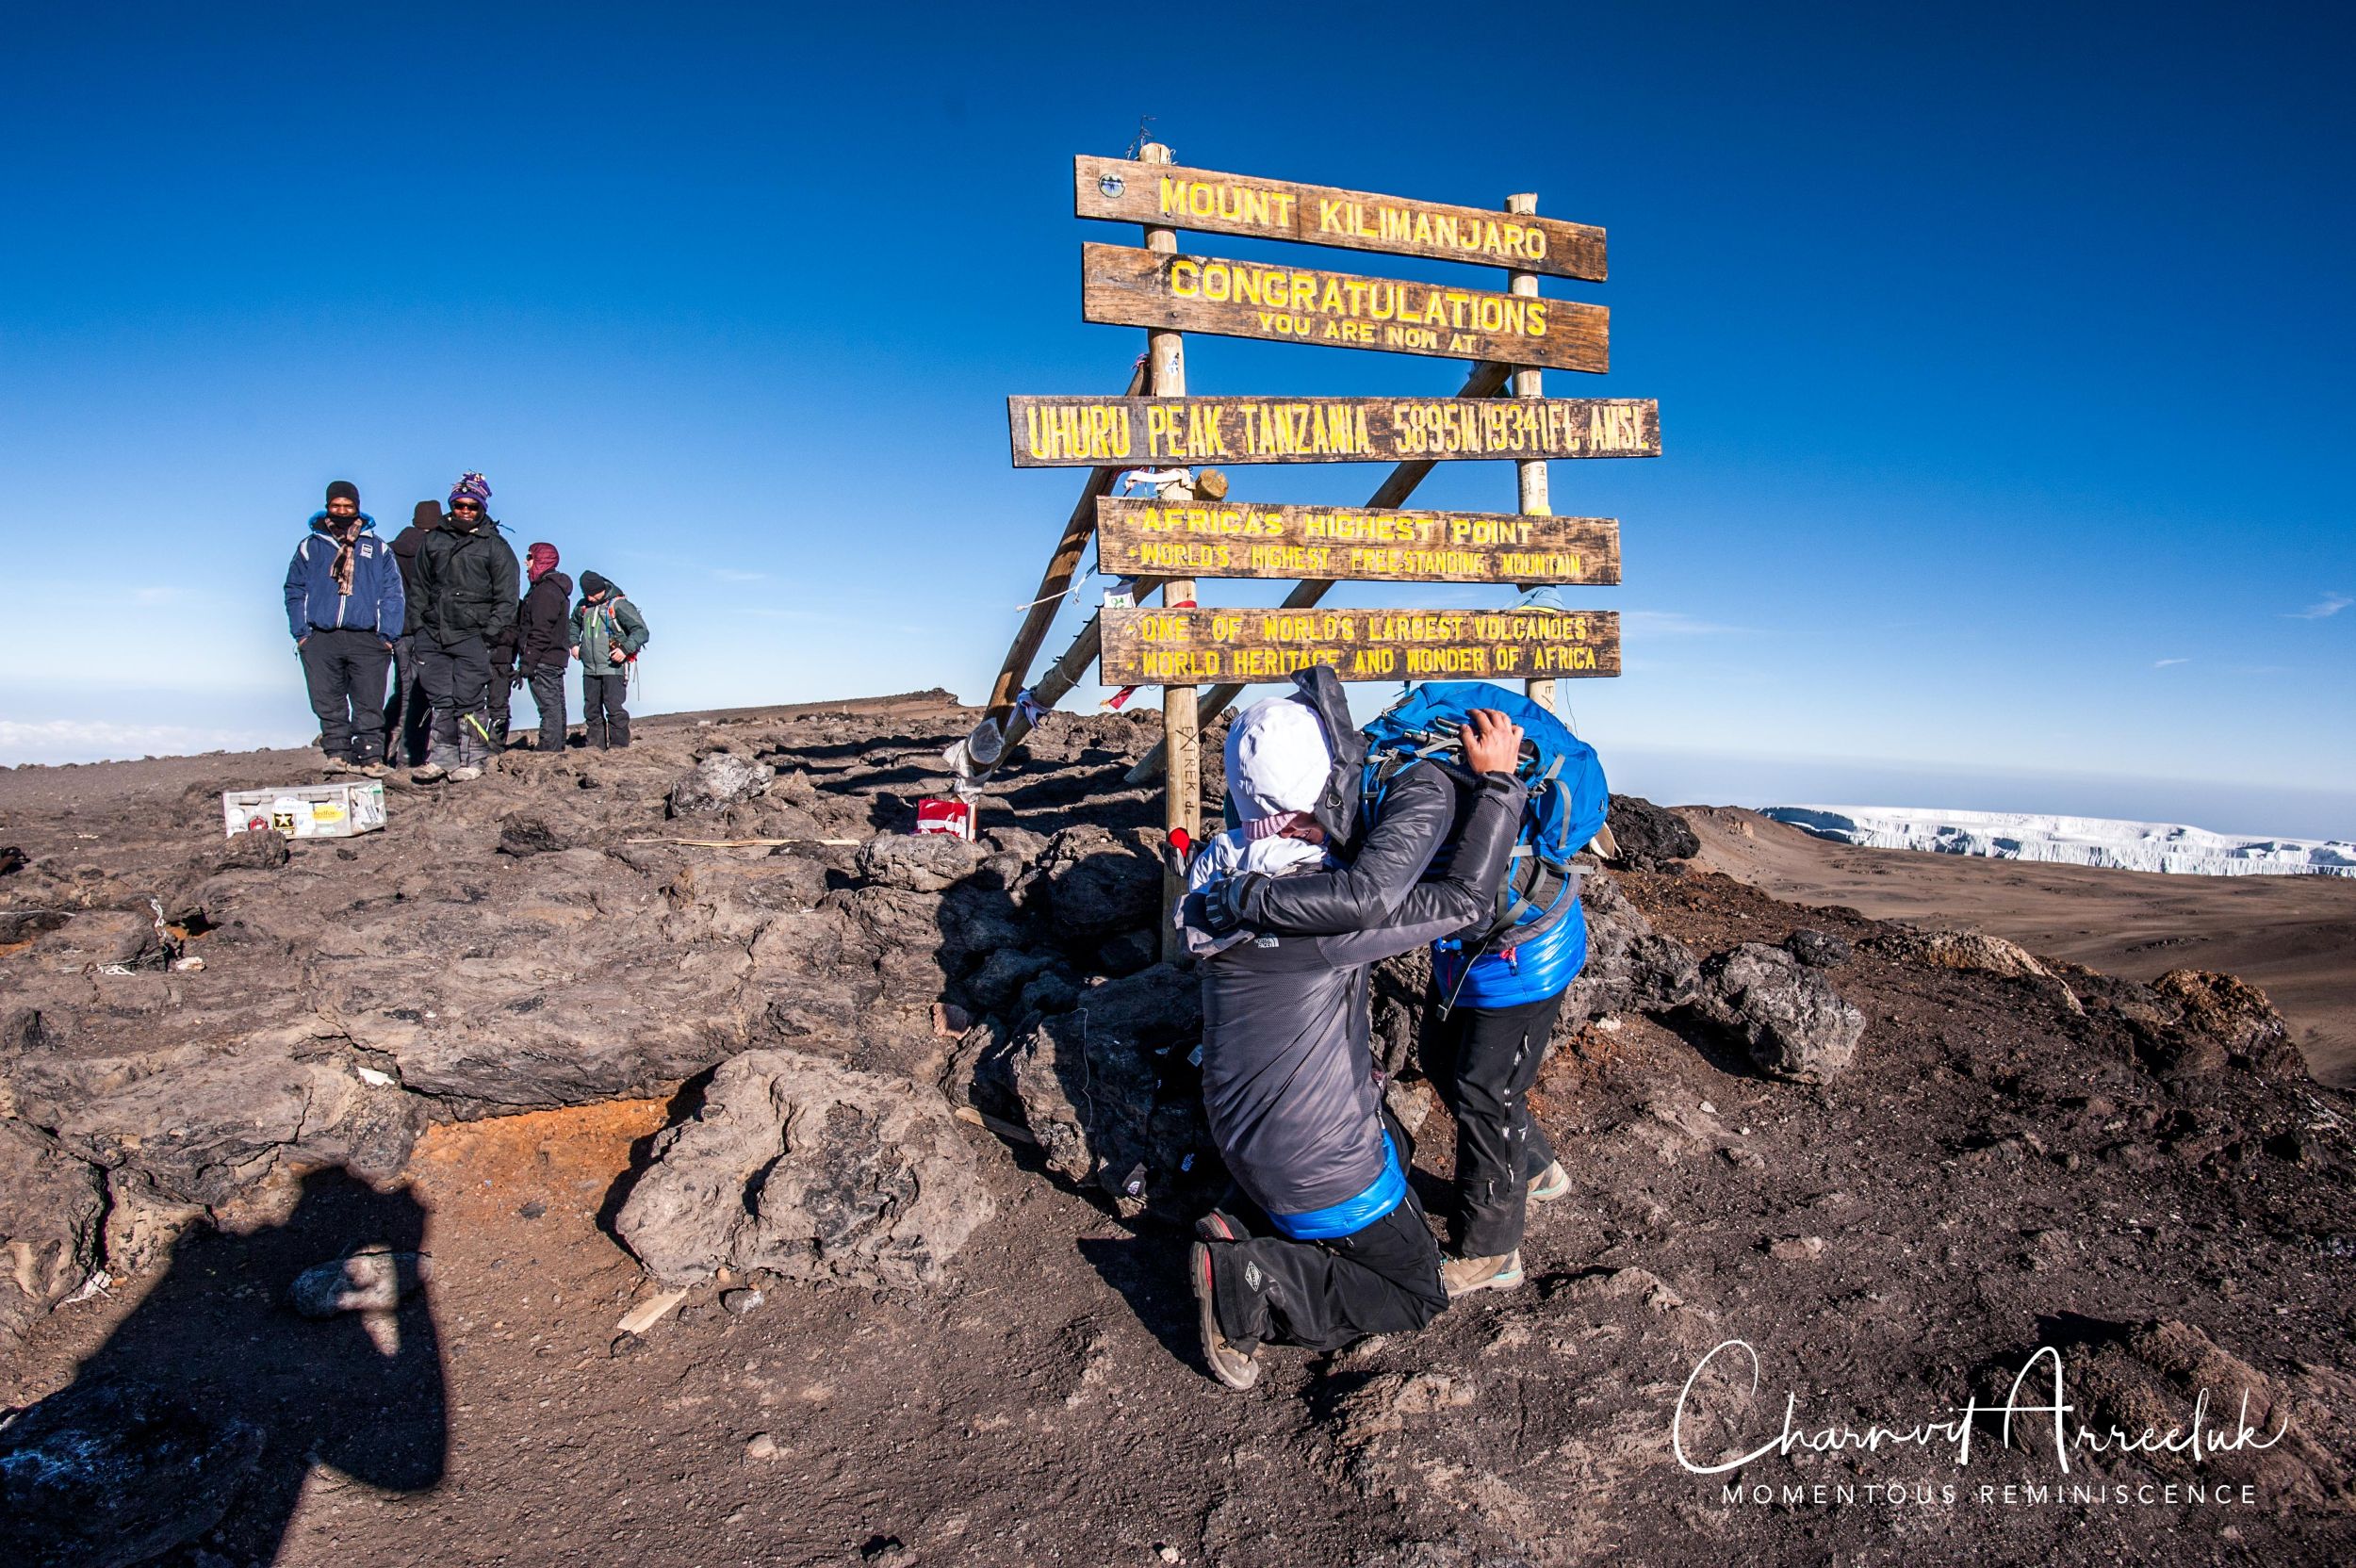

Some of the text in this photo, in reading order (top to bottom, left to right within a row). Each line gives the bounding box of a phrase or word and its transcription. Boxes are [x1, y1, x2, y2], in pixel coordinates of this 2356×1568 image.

[1159, 177, 1546, 260] MOUNT KILIMANJARO
[1170, 260, 1547, 336] CONGRATULATIONS
[1257, 311, 1477, 353] YOU ARE NOW AT
[1027, 405, 1131, 459] UHURU
[1146, 404, 1228, 458] PEAK
[1241, 402, 1371, 456] TANZANIA
[1590, 404, 1649, 451] AMSL
[1305, 514, 1435, 542] HIGHEST
[1452, 518, 1534, 545] POINT
[1251, 545, 1332, 569] HIGHEST
[1501, 552, 1581, 577] MOUNTAIN
[1141, 615, 1190, 642] ONE
[1212, 616, 1242, 641] OF
[1368, 616, 1463, 641] LARGEST
[1473, 617, 1587, 640] VOLCANOES
[1142, 650, 1220, 677] WORLD
[1353, 648, 1395, 673] AND
[1406, 647, 1485, 672] WONDER
[1496, 646, 1520, 671] OF
[1533, 646, 1596, 670] AFRICA
